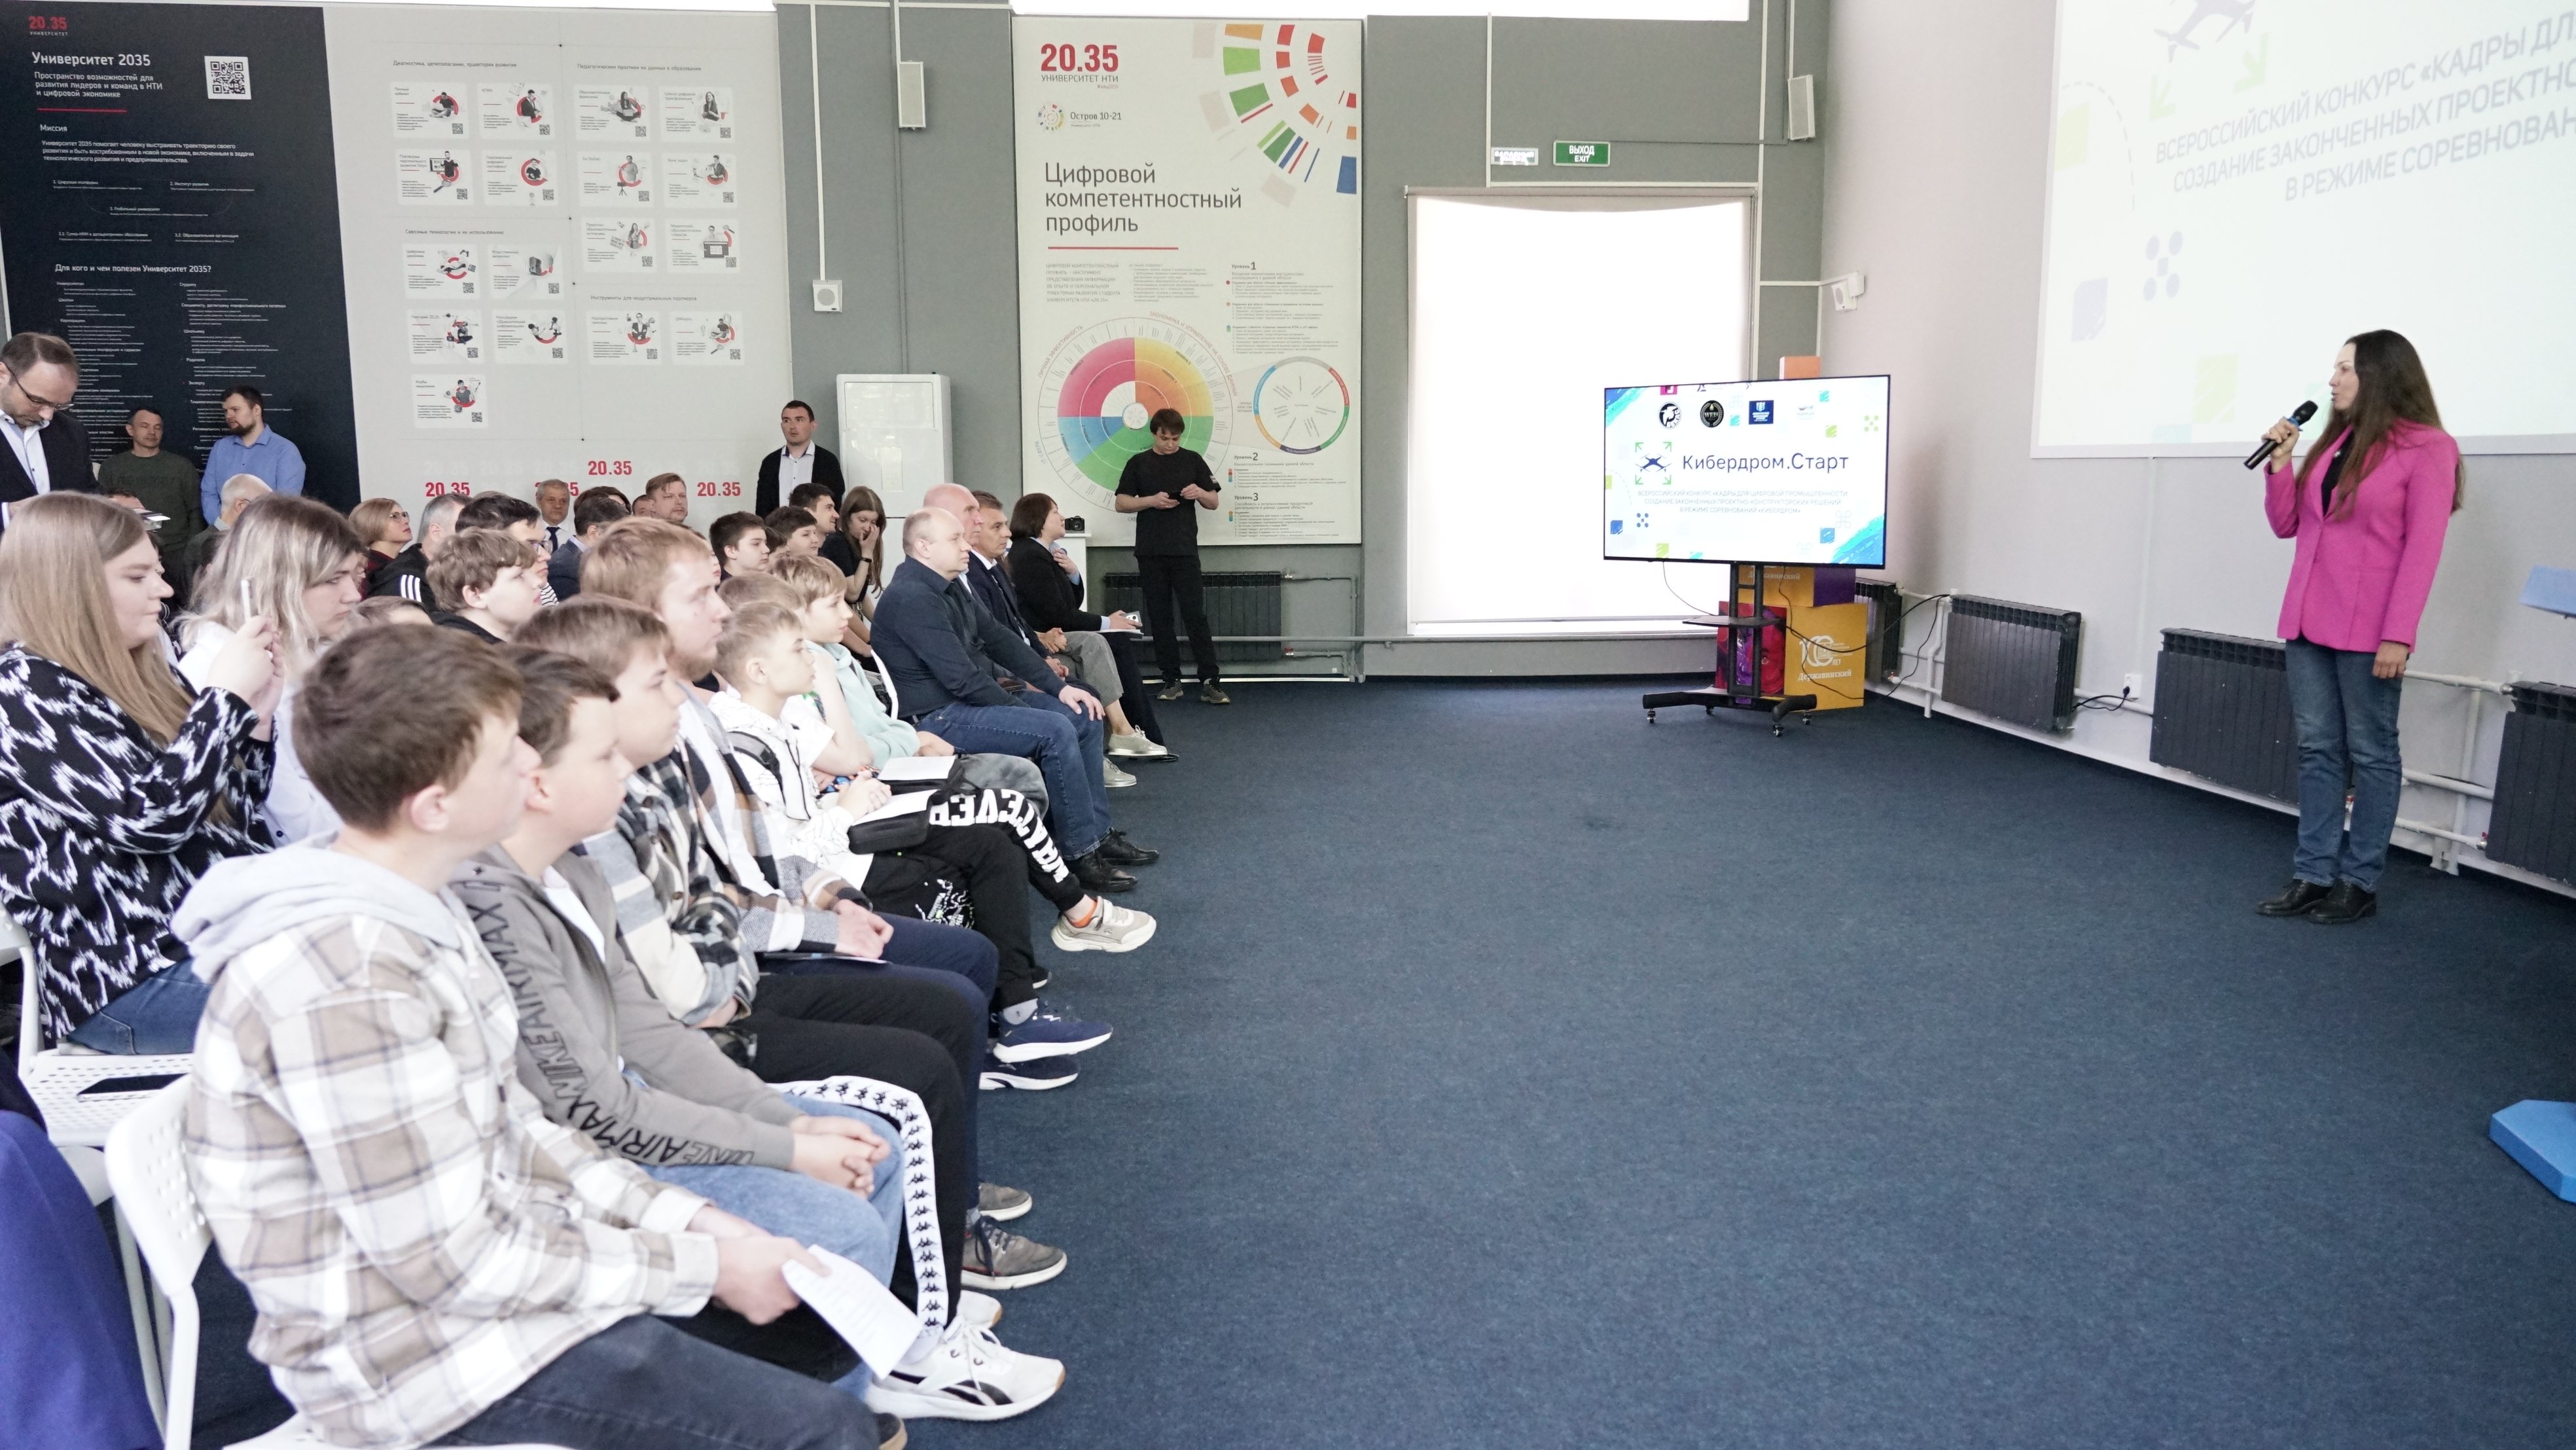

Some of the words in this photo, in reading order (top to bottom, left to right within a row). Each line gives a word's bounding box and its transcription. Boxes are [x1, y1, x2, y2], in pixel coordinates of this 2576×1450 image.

[31, 51, 114, 67] Университет
[118, 54, 151, 66] 2035
[1041, 43, 1119, 73] 20.35
[34, 71, 84, 81] Пространство
[86, 73, 137, 82] возможностей
[1041, 74, 1099, 83] УНИВЕРСИТЕТ
[1101, 75, 1118, 83] НТИ
[43, 89, 80, 98] цифровой
[71, 82, 101, 91] лидеров
[2156, 90, 2310, 164] ВСЕРОССИЙСКИЙ
[2314, 63, 2416, 118] КОНКУРС
[2420, 27, 2527, 82] «КАДРЫ
[2530, 10, 2576, 57] ДЛ
[1070, 111, 1098, 122] Остров
[1100, 111, 1122, 121] 10-21
[1569, 145, 1595, 156] ВЫХОД
[2174, 147, 2267, 193] СОЗДАНИЕ
[2270, 99, 2433, 169] ЗАКОНЧЕННЫХ
[1045, 162, 1156, 186] Цифровой
[2285, 177, 2297, 202] В
[2301, 151, 2398, 199] РЕЖИМЕ
[1045, 187, 1242, 209] компетентностный
[1046, 215, 1139, 236] профиль
[55, 264, 70, 273] Для
[142, 264, 187, 274] Университет
[1250, 261, 1257, 270] 1
[1253, 452, 1258, 461] 2
[1683, 452, 1850, 473] Кибердром.Старт
[588, 461, 632, 476] 20.35
[697, 482, 742, 497] 20.35
[1253, 492, 1259, 501] 3
